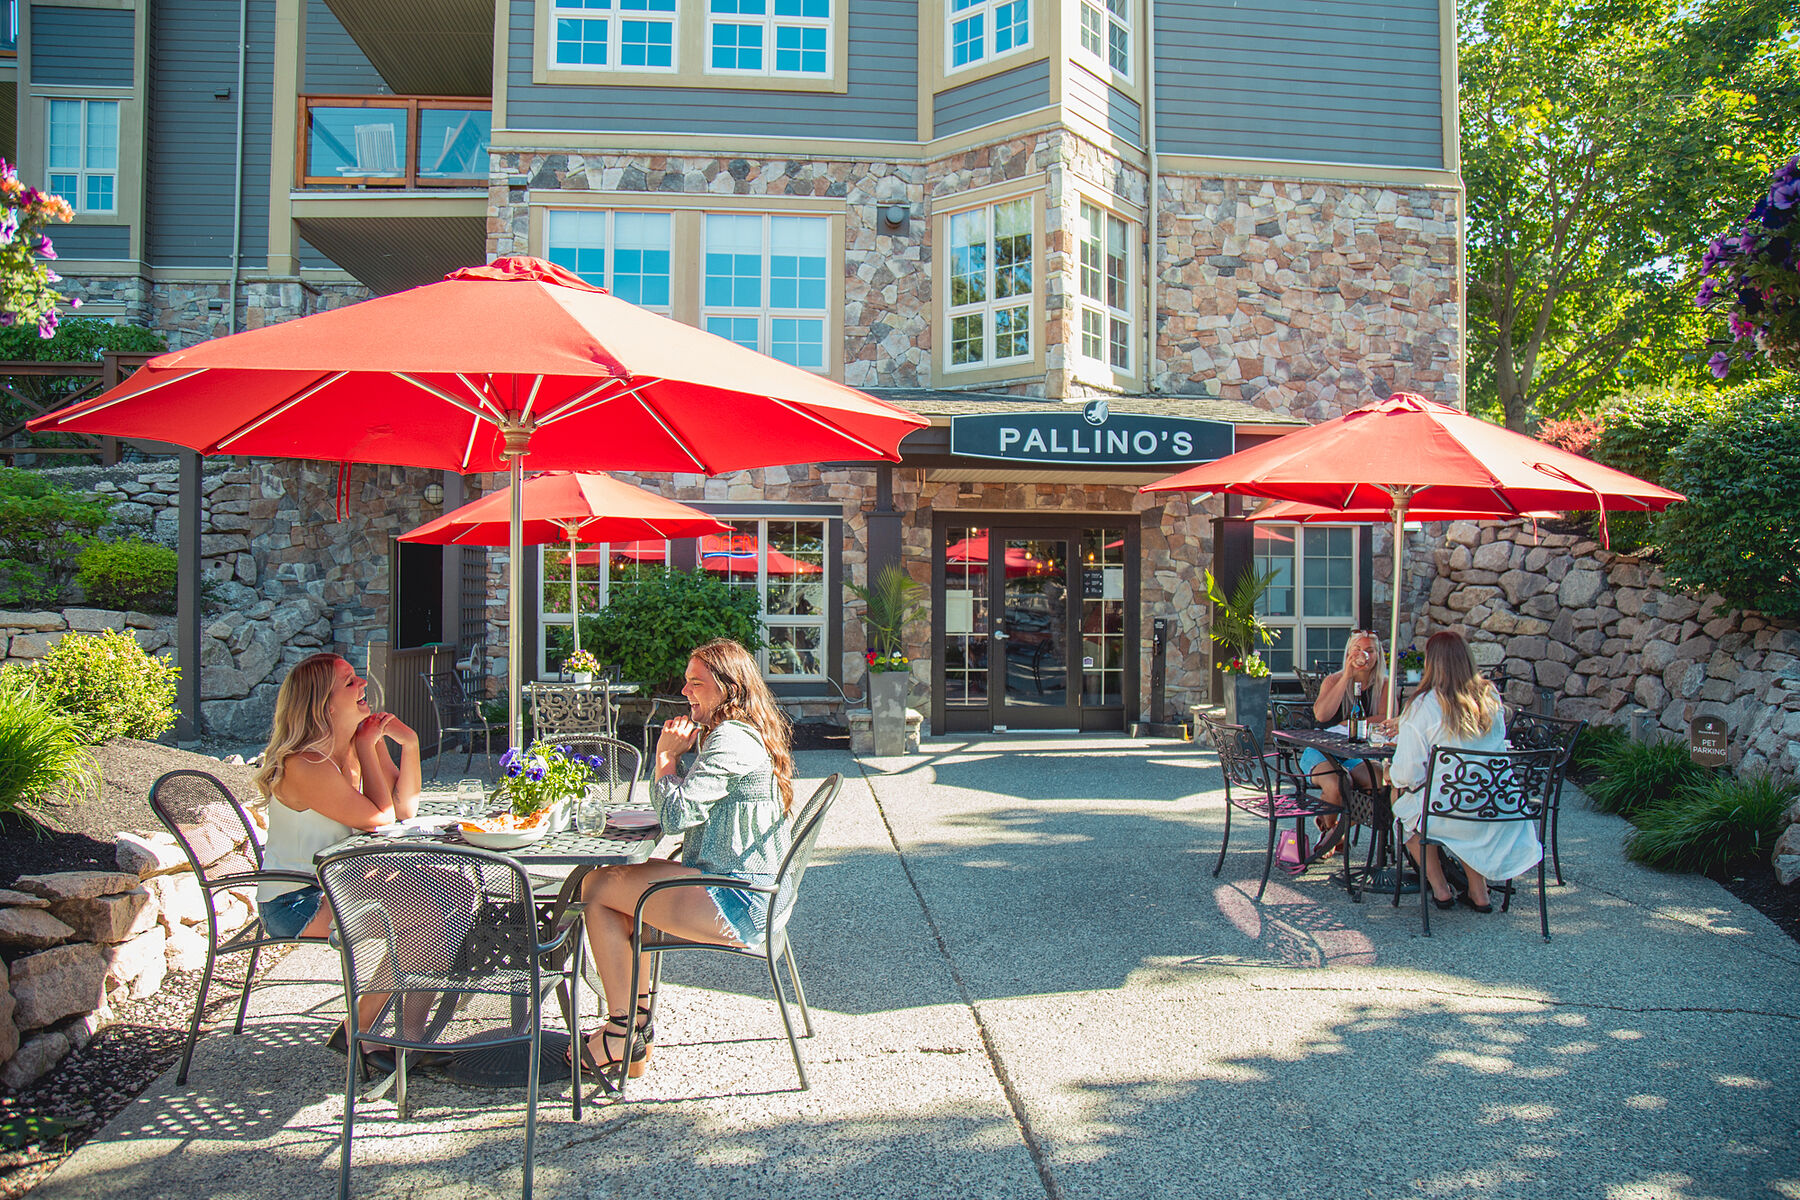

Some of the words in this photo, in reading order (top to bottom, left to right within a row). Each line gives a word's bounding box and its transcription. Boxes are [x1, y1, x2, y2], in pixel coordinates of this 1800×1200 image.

[1000, 427, 1194, 456] PALLINO'S
[703, 534, 758, 553] OPEN
[1702, 739, 1717, 747] PET
[1692, 746, 1727, 756] PARKING
